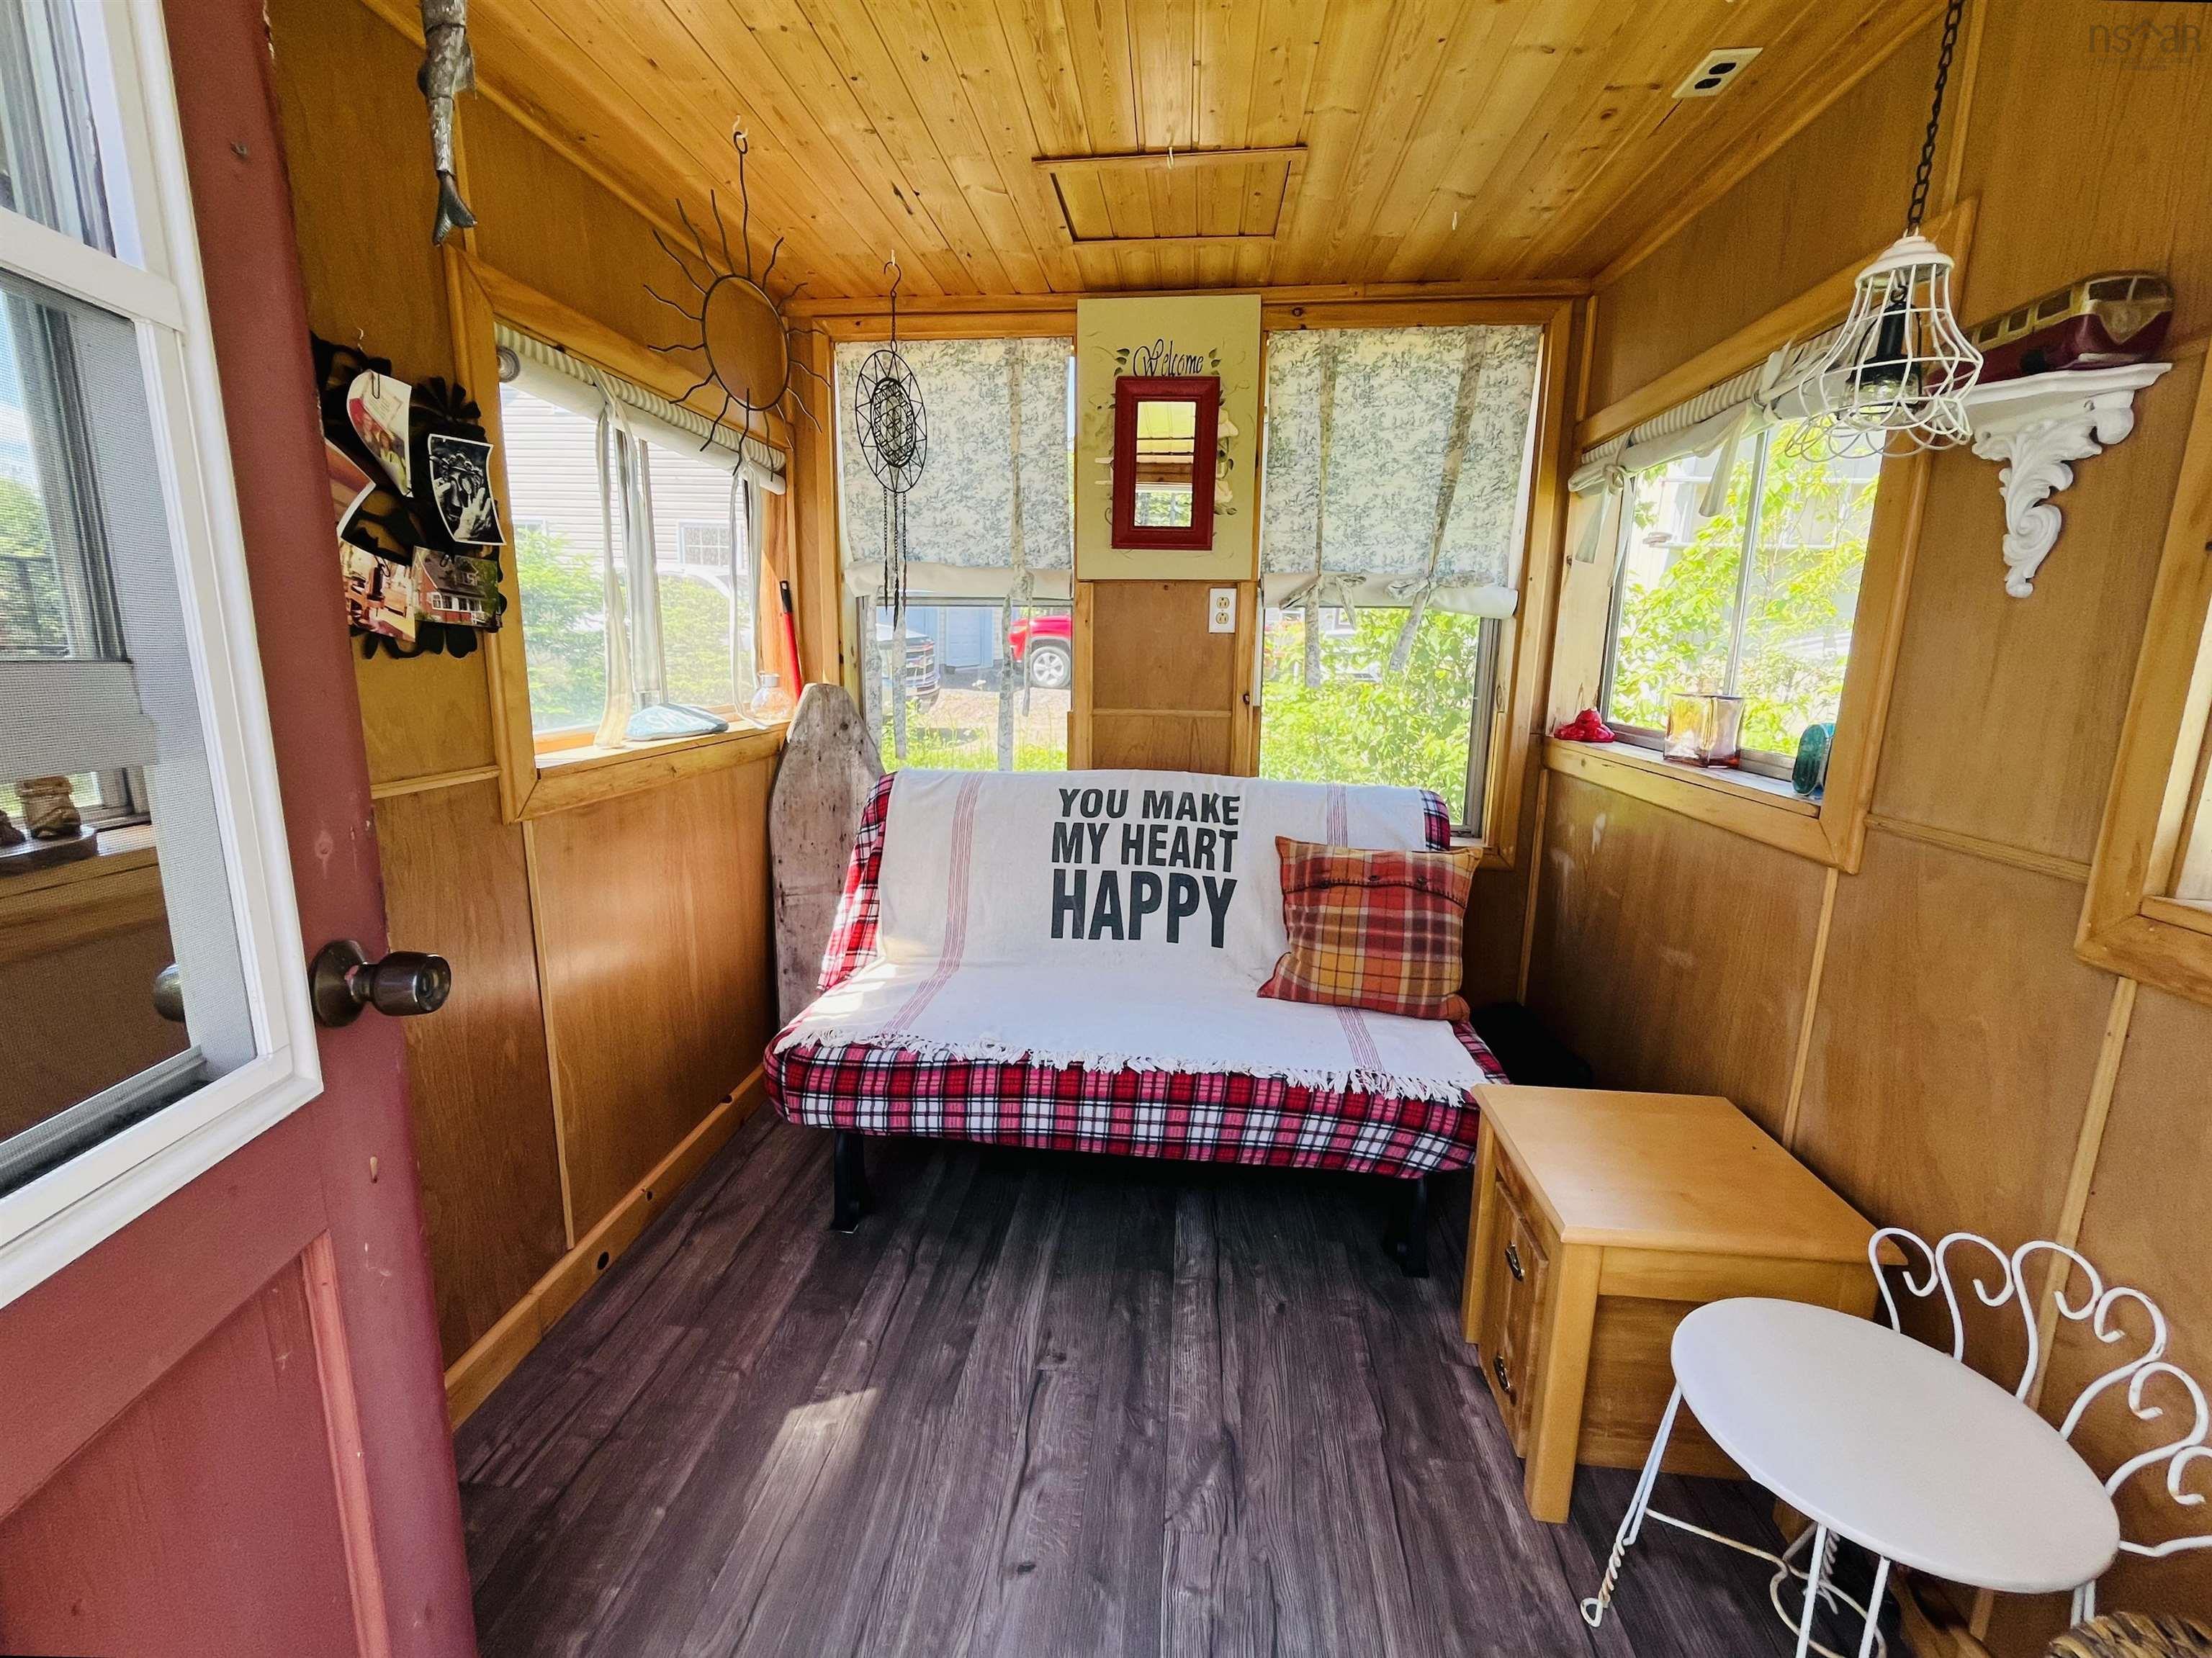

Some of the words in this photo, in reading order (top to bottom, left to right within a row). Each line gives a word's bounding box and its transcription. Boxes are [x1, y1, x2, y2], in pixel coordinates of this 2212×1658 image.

[1133, 338, 1204, 377] Welcome
[1058, 788, 1129, 819] YOU
[1142, 790, 1241, 826] MAKE
[1051, 821, 1110, 864] MY
[1120, 823, 1238, 873] HEART
[1051, 868, 1238, 949] HAPPY
